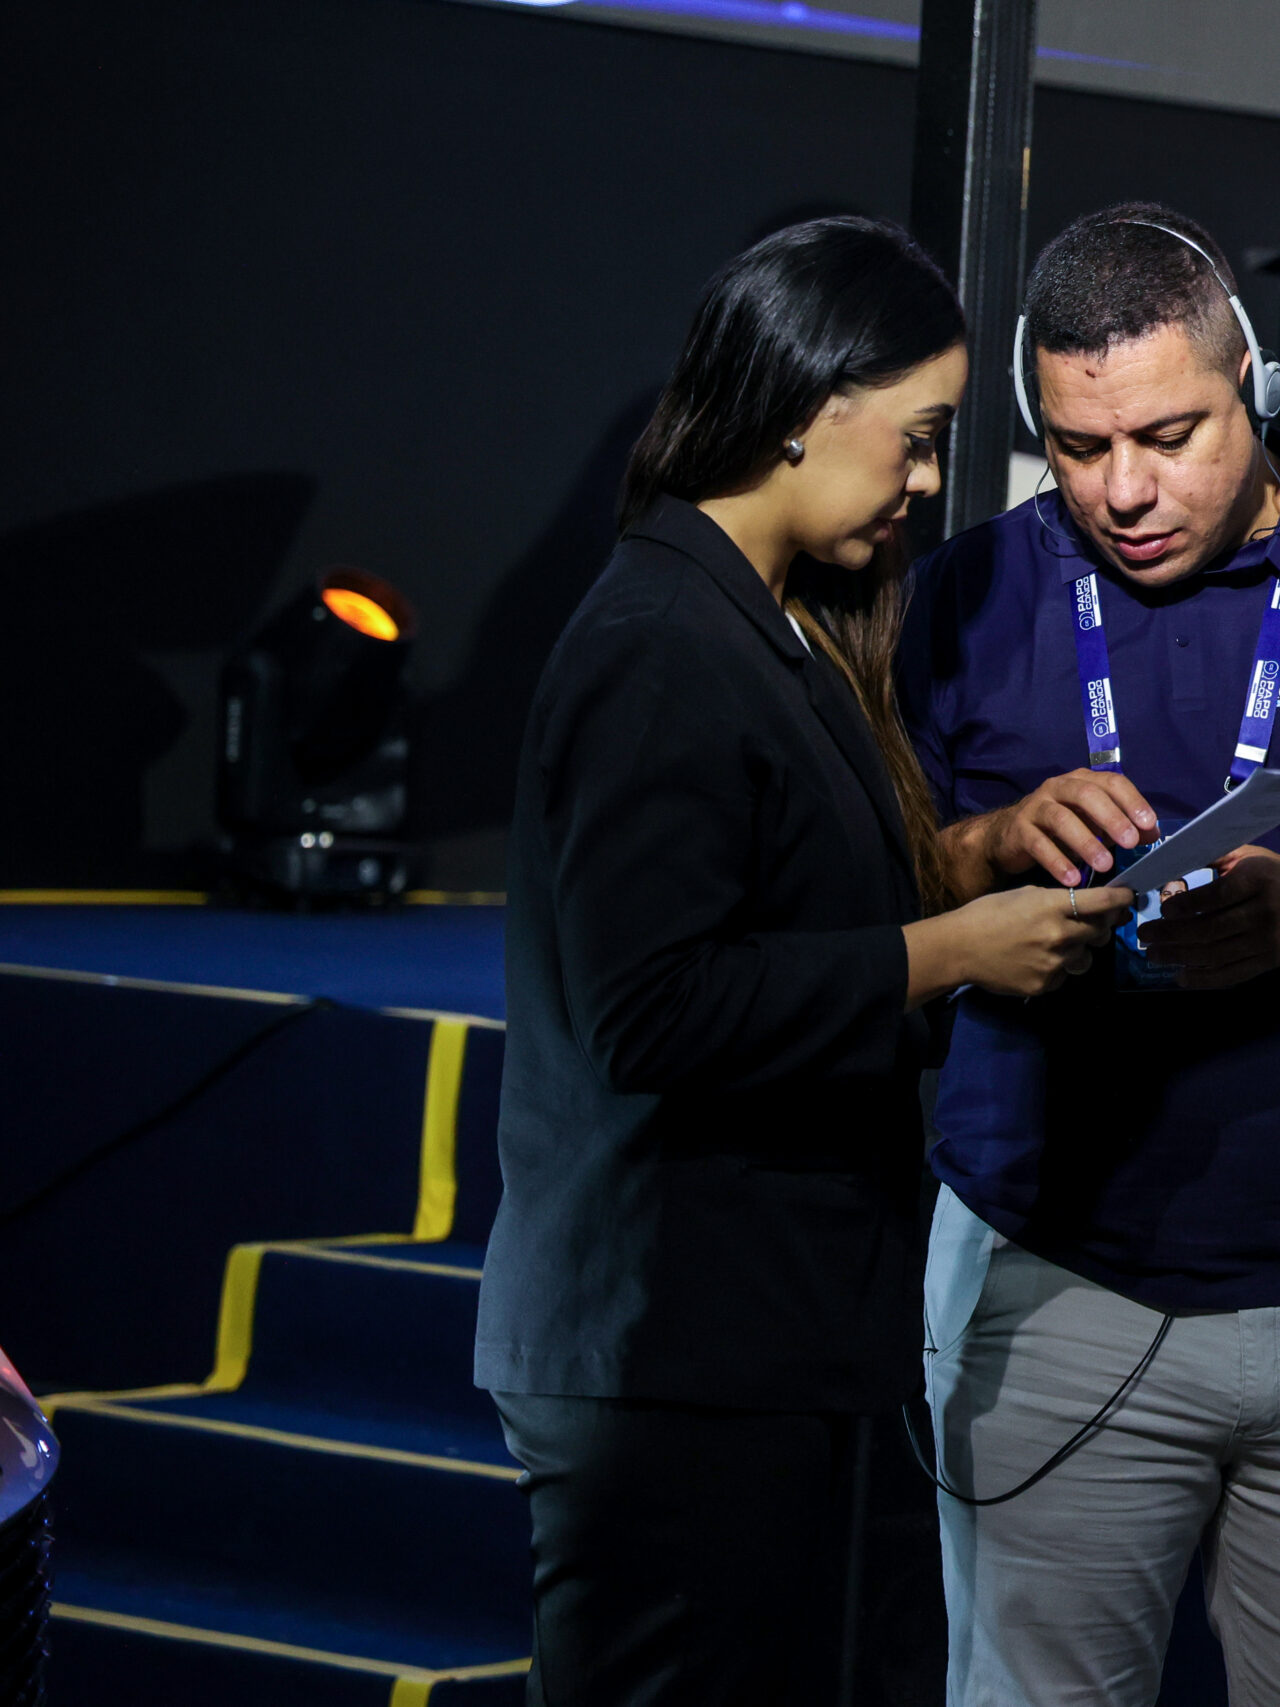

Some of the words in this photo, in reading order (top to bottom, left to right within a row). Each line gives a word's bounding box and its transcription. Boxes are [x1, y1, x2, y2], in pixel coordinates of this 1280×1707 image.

[1076, 578, 1086, 612] PAPO
[1088, 681, 1100, 718] PAPO
[1253, 680, 1266, 718] CONDO
[1260, 680, 1275, 719] PAPO
